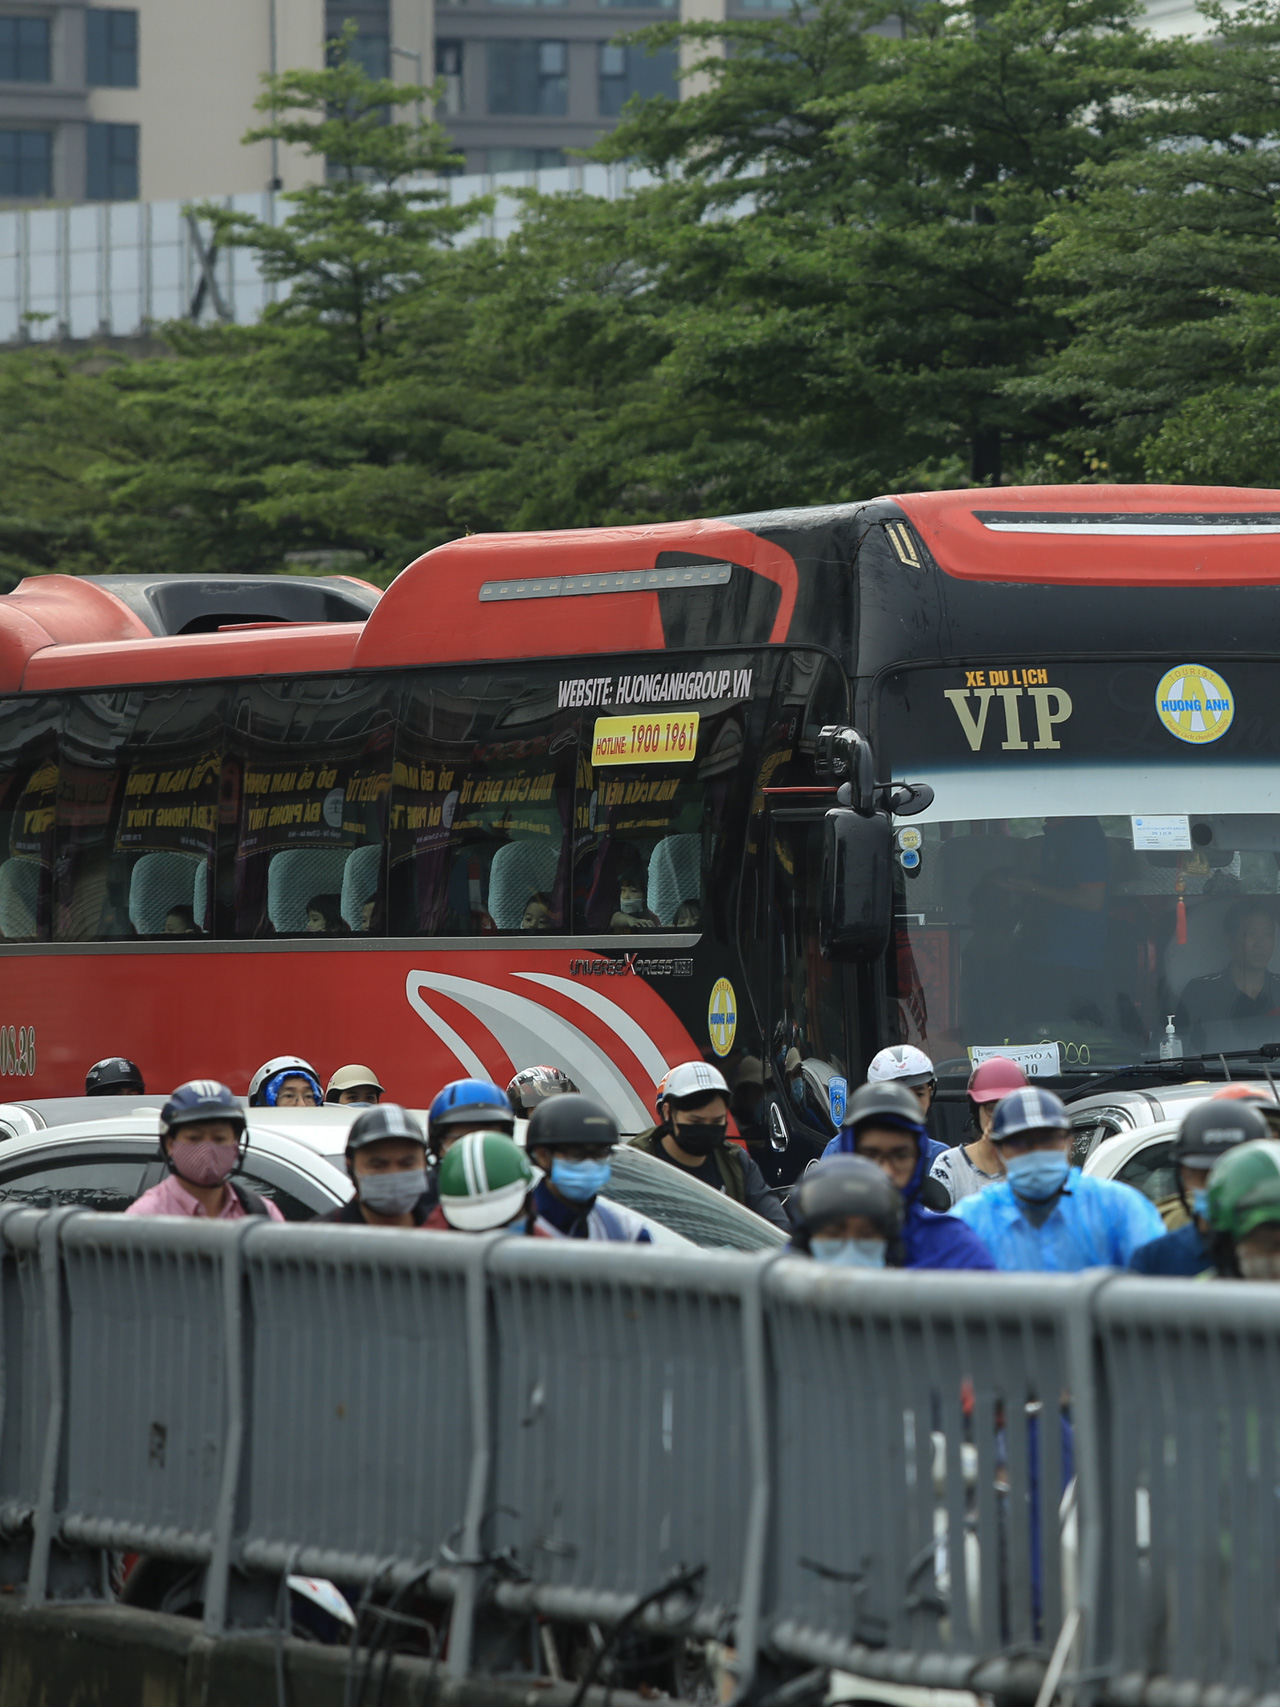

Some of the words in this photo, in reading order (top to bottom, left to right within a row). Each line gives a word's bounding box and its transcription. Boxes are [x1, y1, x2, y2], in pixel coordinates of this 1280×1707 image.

[965, 671, 986, 687] XE
[989, 670, 1010, 686] DU
[1012, 668, 1048, 688] LỊCH
[1167, 668, 1216, 681] TOURIST
[558, 676, 613, 708] WEBSITE:
[615, 669, 753, 705] HUONGANHGROUP.VN
[1161, 699, 1202, 712] HUONG
[1206, 699, 1230, 712] ANH
[943, 687, 1073, 751] VIP
[630, 724, 660, 754] 1900
[665, 722, 695, 752] 1961
